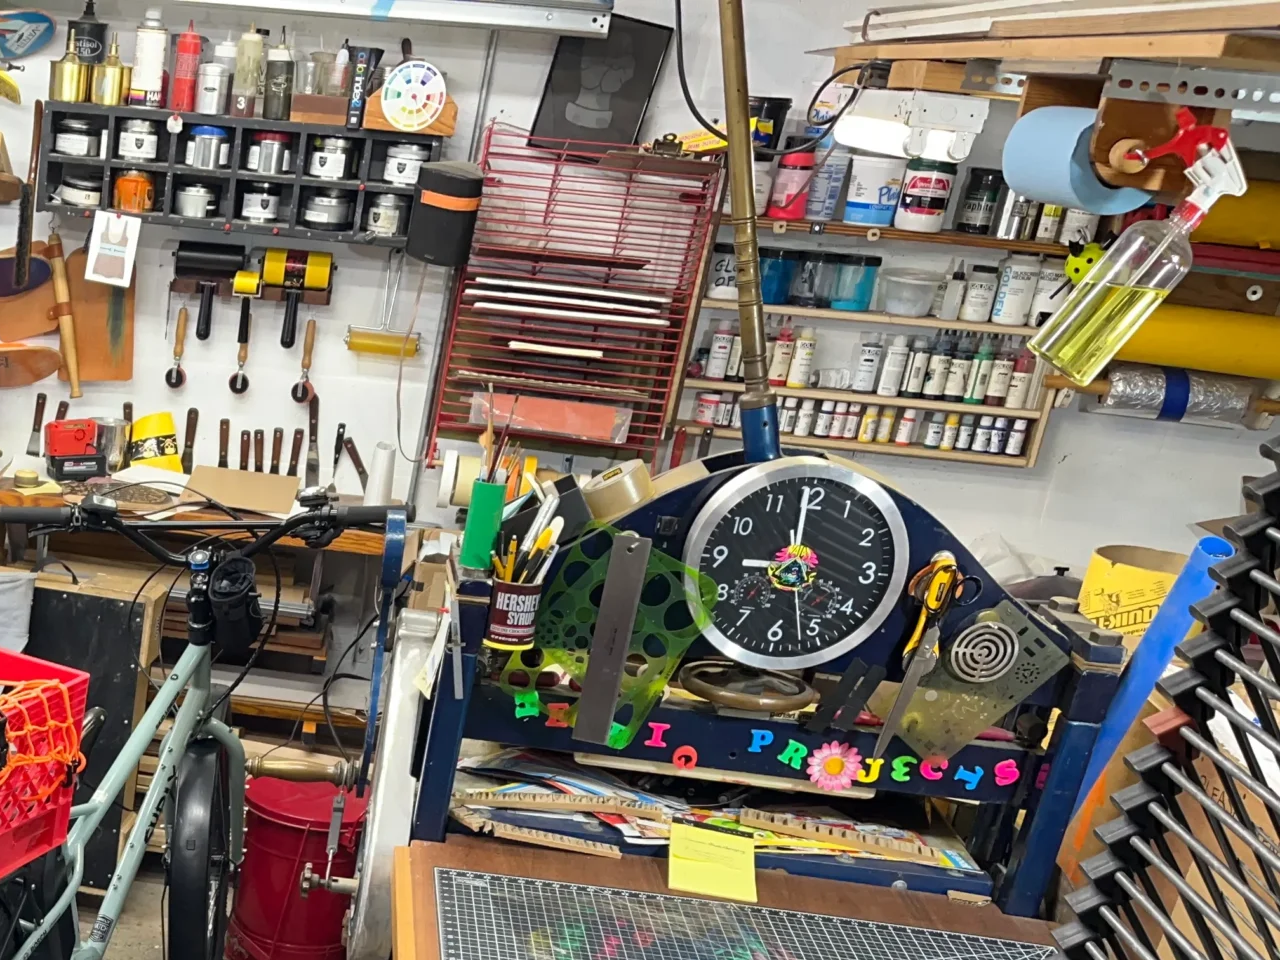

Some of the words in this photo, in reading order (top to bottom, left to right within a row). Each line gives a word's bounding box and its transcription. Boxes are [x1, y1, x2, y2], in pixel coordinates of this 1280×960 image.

[236, 96, 246, 110] 3
[993, 265, 1013, 317] GOLDEN
[766, 494, 784, 513] 11
[801, 485, 825, 510] 12
[843, 500, 851, 518] 1
[733, 517, 753, 535] 10
[859, 528, 875, 546] 2
[712, 546, 728, 568] 9
[858, 562, 876, 584] 3
[840, 598, 853, 615] 4
[506, 611, 536, 626] SYRUP
[736, 609, 751, 626] 7
[1091, 603, 1160, 630] QUIK-T
[767, 619, 783, 641] 6
[806, 619, 821, 636] 5
